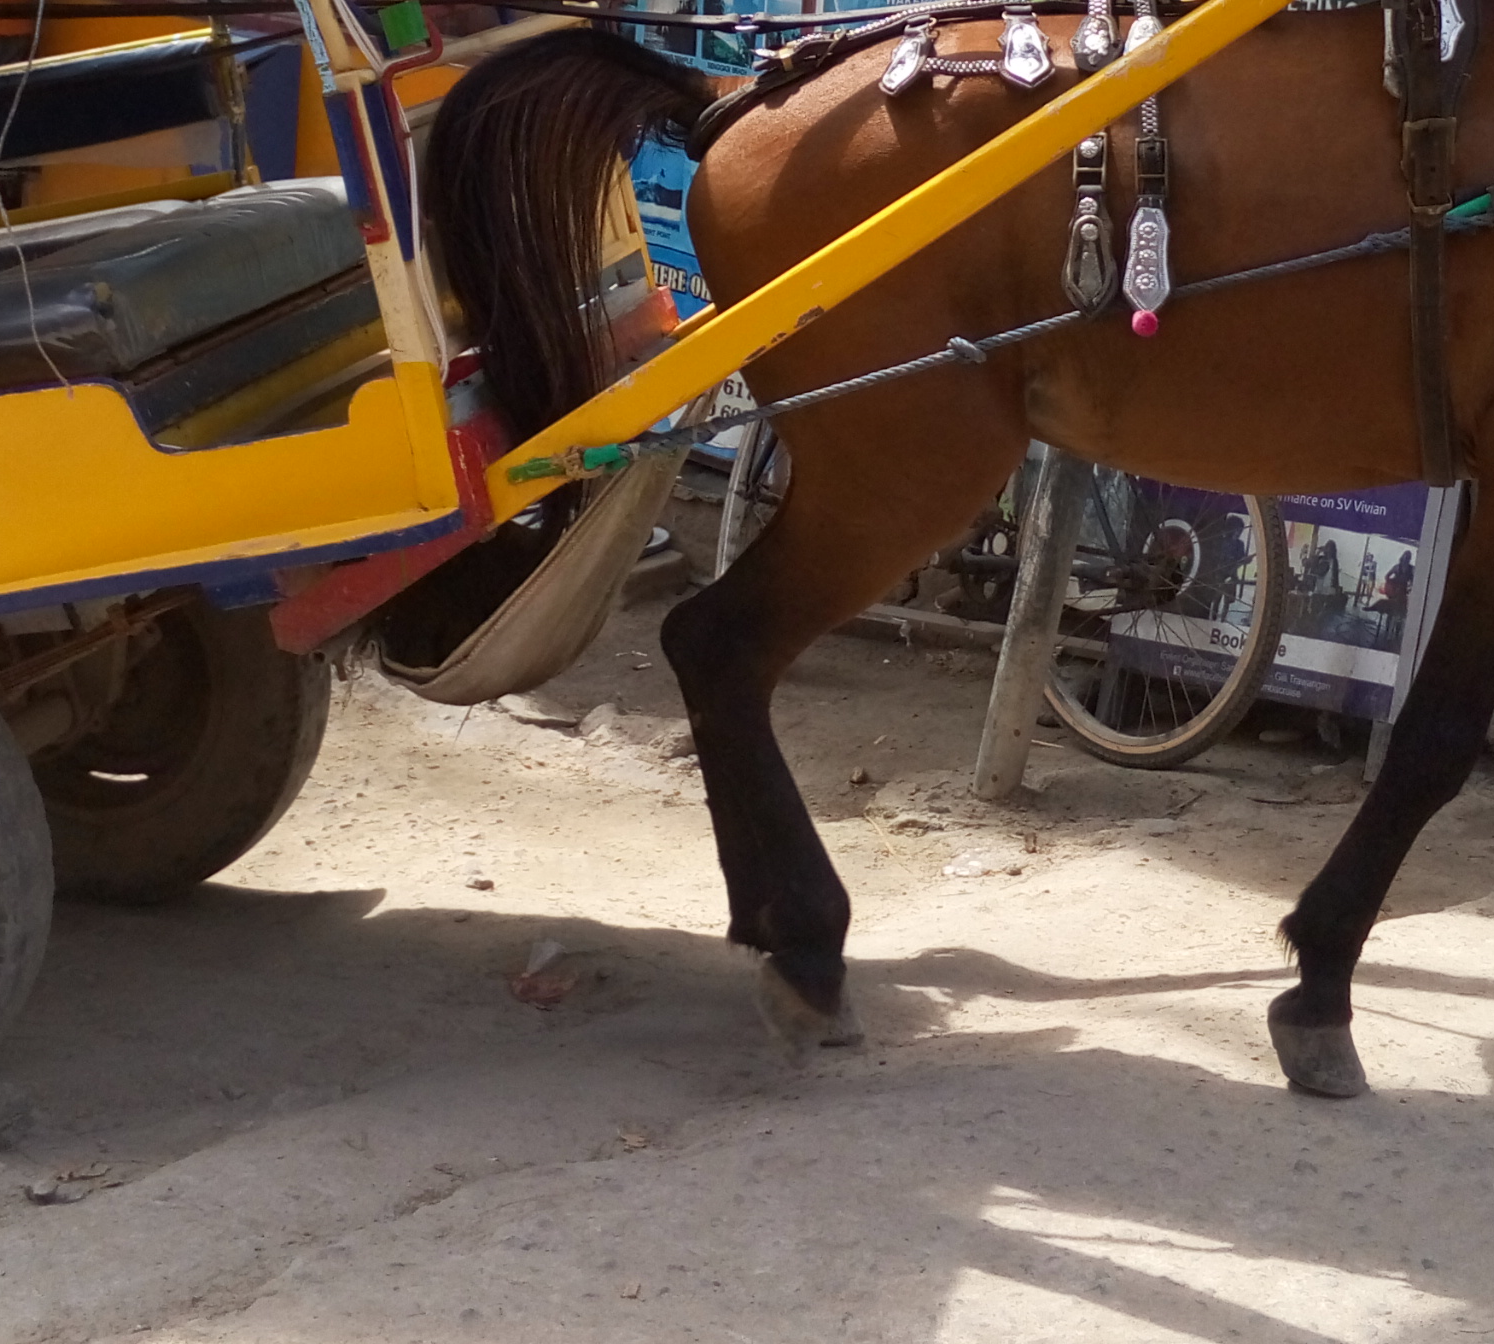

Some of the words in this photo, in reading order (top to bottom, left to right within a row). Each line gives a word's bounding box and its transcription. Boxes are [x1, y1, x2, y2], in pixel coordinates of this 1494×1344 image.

[1320, 497, 1335, 509] on
[1336, 497, 1353, 511] SV
[1354, 500, 1387, 516] Vivian
